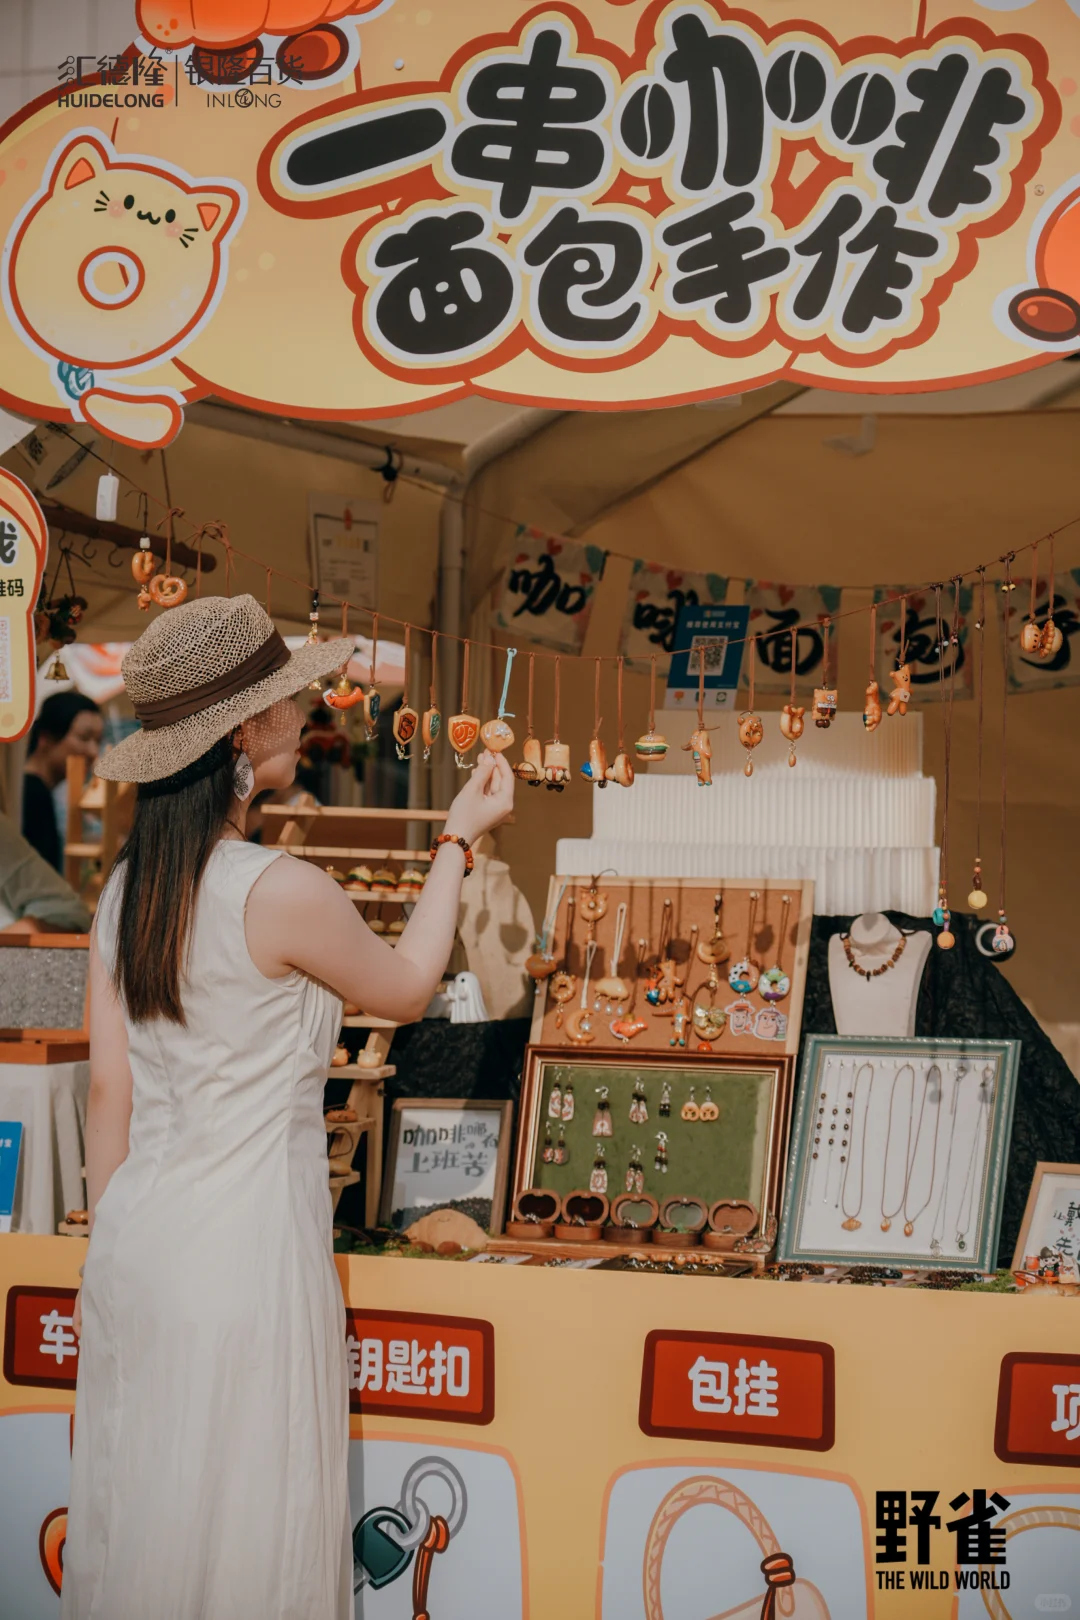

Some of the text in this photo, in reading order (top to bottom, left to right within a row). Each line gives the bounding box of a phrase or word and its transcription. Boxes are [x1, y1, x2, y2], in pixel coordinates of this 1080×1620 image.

[286, 13, 1026, 219] 一串咖啡
[375, 191, 939, 355] 面包手作
[0, 578, 24, 598] 码
[756, 608, 825, 677] 面
[403, 1149, 489, 1178] 上班苦
[39, 1309, 80, 1365] 车
[346, 1335, 470, 1397] 钥匙扣
[687, 1355, 780, 1417] 包挂
